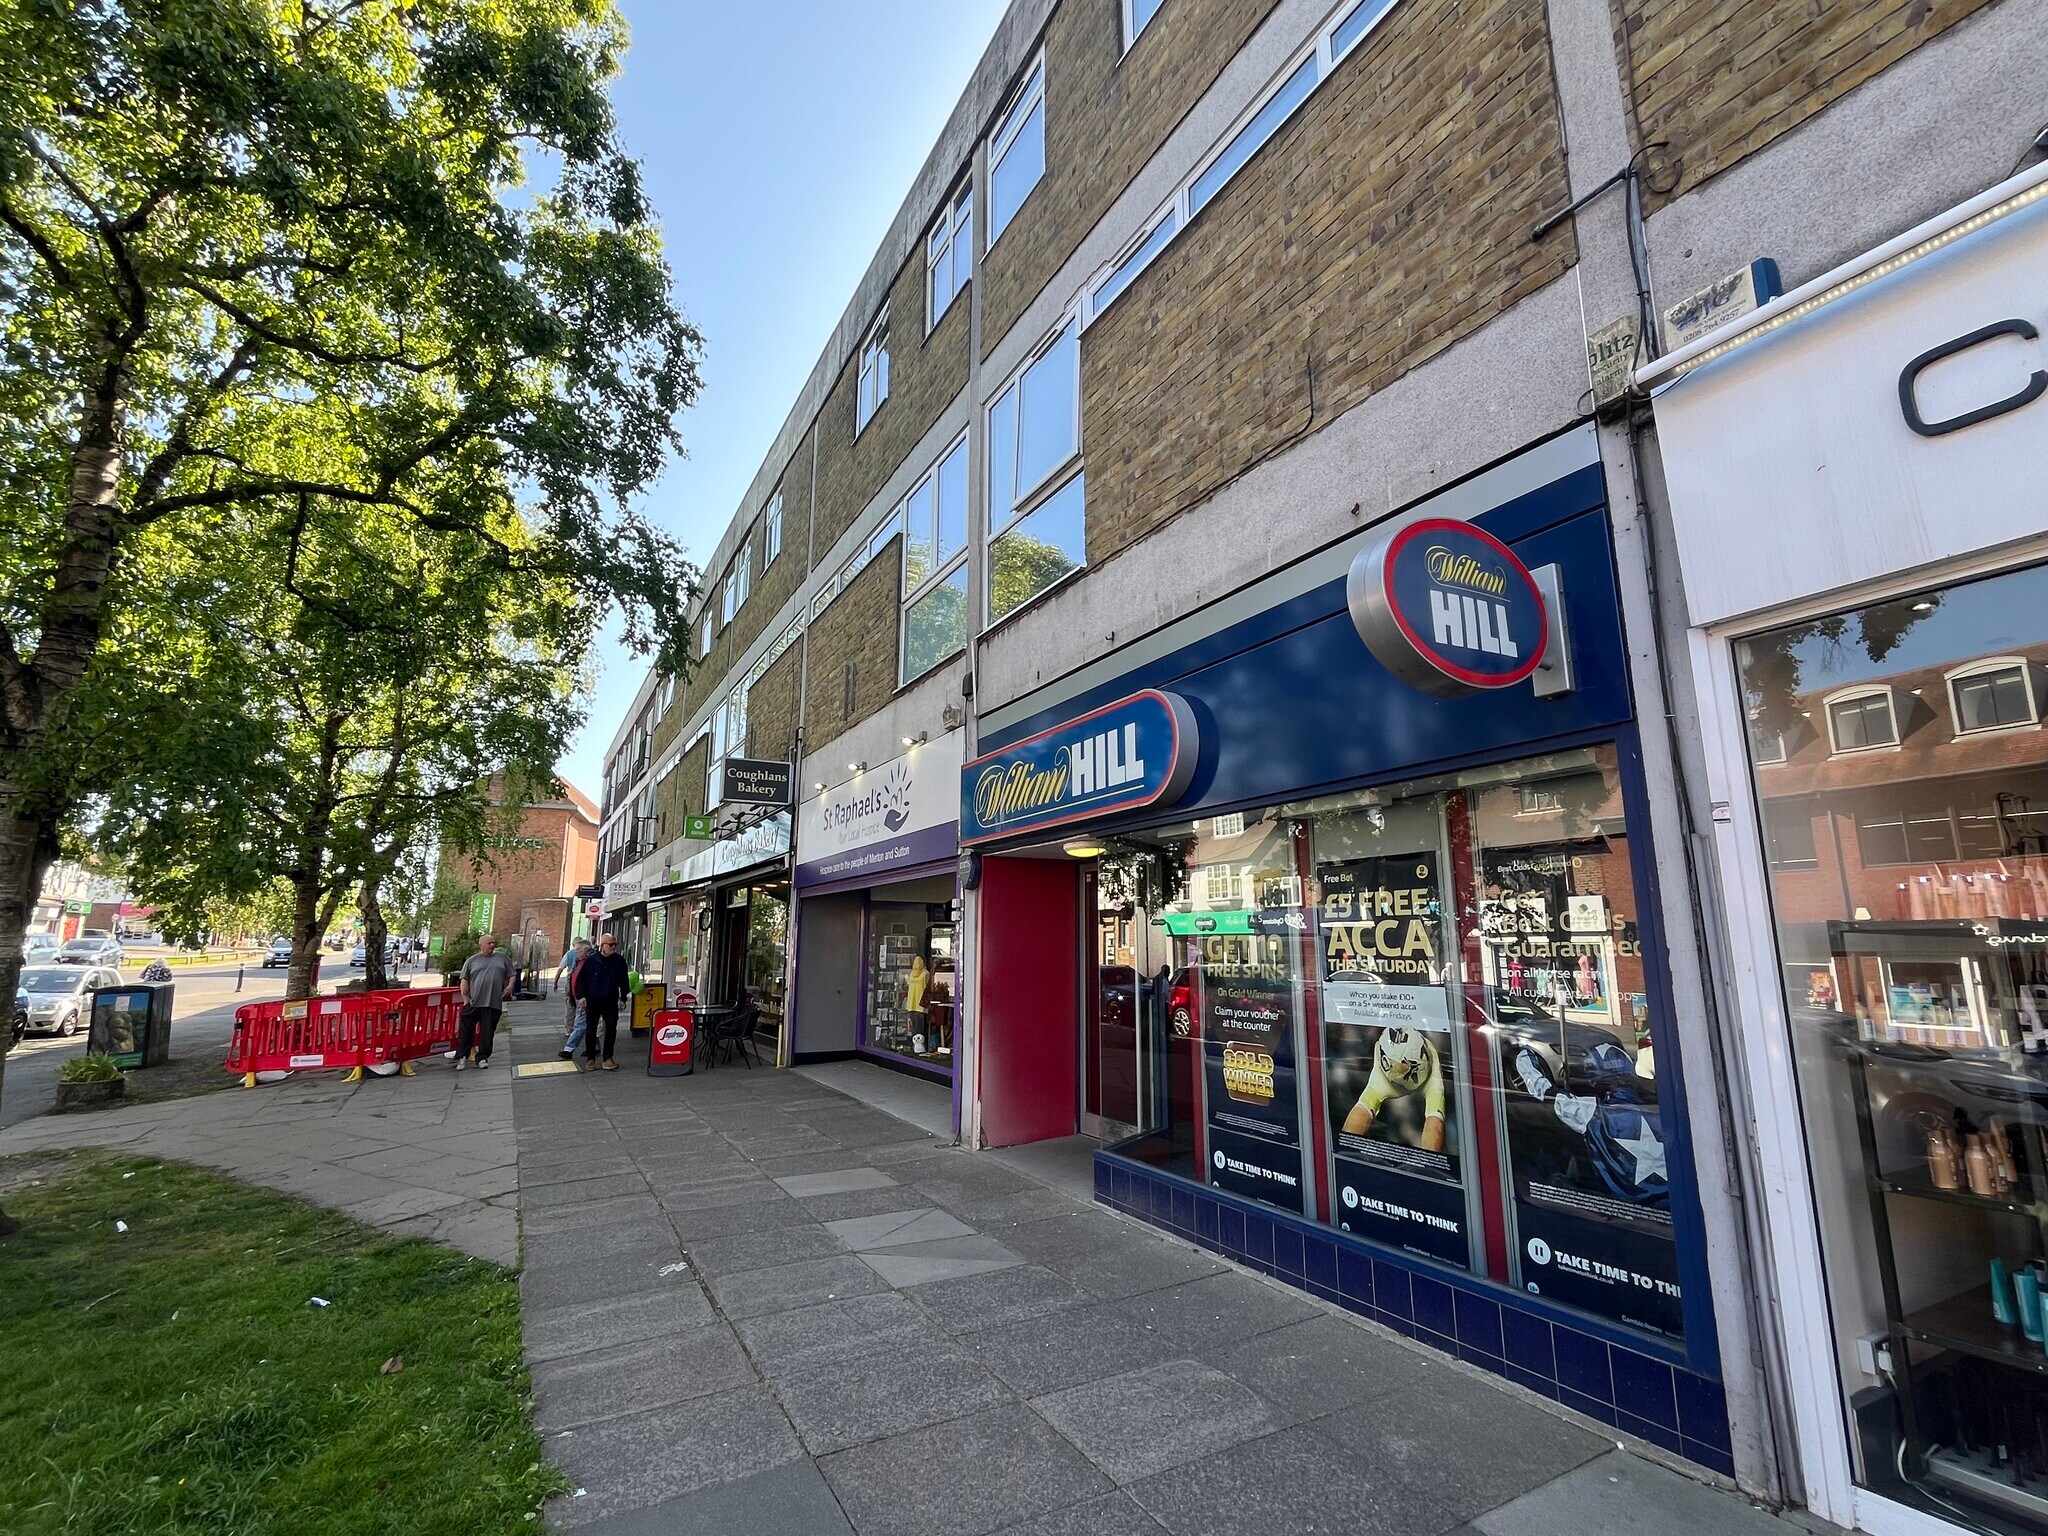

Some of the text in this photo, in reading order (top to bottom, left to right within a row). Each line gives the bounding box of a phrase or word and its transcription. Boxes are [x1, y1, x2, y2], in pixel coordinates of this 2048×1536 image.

[1424, 545, 1507, 596] William
[1430, 590, 1518, 658] HILL
[727, 768, 787, 782] Coughlans
[974, 722, 1144, 824] William HILL
[737, 782, 776, 797] Bakery
[823, 788, 881, 831] St Raphael's
[850, 856, 864, 870] people
[869, 852, 884, 864] Merton
[884, 848, 894, 860] and
[1324, 874, 1353, 884] Free Bet
[1325, 888, 1431, 918] £5 FREE
[1560, 909, 1626, 932] Os
[1207, 934, 1283, 962] GET 10
[1327, 919, 1435, 957] ACCA
[1207, 962, 1285, 980] FREE SPINS
[1328, 959, 1435, 974] THIS SATURDAY
[1507, 969, 1521, 978] on
[1217, 988, 1275, 1000] On Gold Winner
[1372, 1001, 1399, 1009] weekend
[1509, 987, 1522, 997] All
[1603, 991, 1639, 1003] sops
[1214, 1005, 1280, 1020] Claim your voucher
[1222, 1019, 1271, 1032] at the counter
[1223, 1049, 1274, 1075] GOLD
[1223, 1068, 1274, 1098] WINNER
[1227, 1158, 1243, 1170] TAKE
[1244, 1164, 1261, 1176] TIME
[1262, 1168, 1272, 1178] TO
[1273, 1171, 1296, 1186] THINK
[1360, 1196, 1458, 1233] TAKE TIME TO THINK
[1554, 1251, 1590, 1271] TAKE
[1592, 1261, 1629, 1283] TIME
[1631, 1272, 1653, 1289] TO
